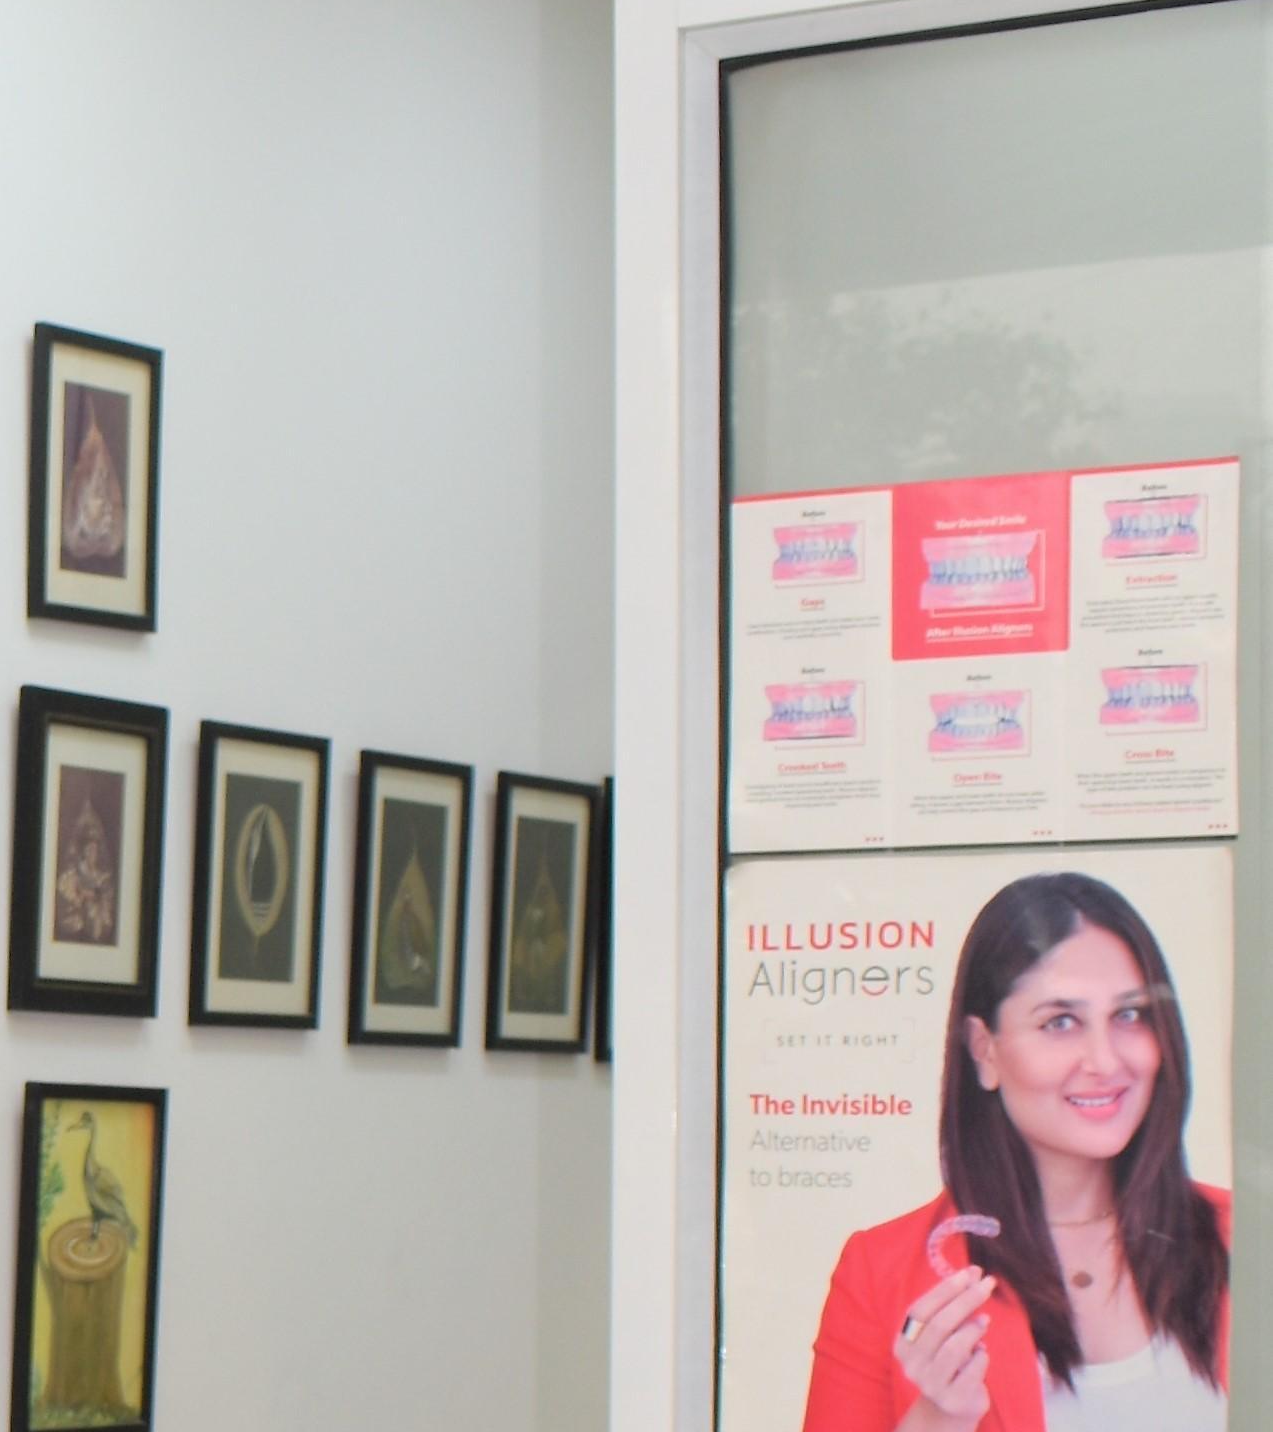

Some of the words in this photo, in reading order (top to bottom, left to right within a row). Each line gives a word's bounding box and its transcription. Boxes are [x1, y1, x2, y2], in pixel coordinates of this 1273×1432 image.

[748, 921, 934, 951] ILLUSION
[748, 960, 934, 1005] Aligners
[777, 1035, 805, 1047] SET
[817, 1035, 833, 1046] IT
[843, 1034, 899, 1046] RIGHT
[750, 1094, 795, 1115] The
[802, 1093, 913, 1115] Invisible
[750, 1130, 871, 1152] Alternative
[750, 1168, 772, 1187] to
[778, 1165, 852, 1188] braces
